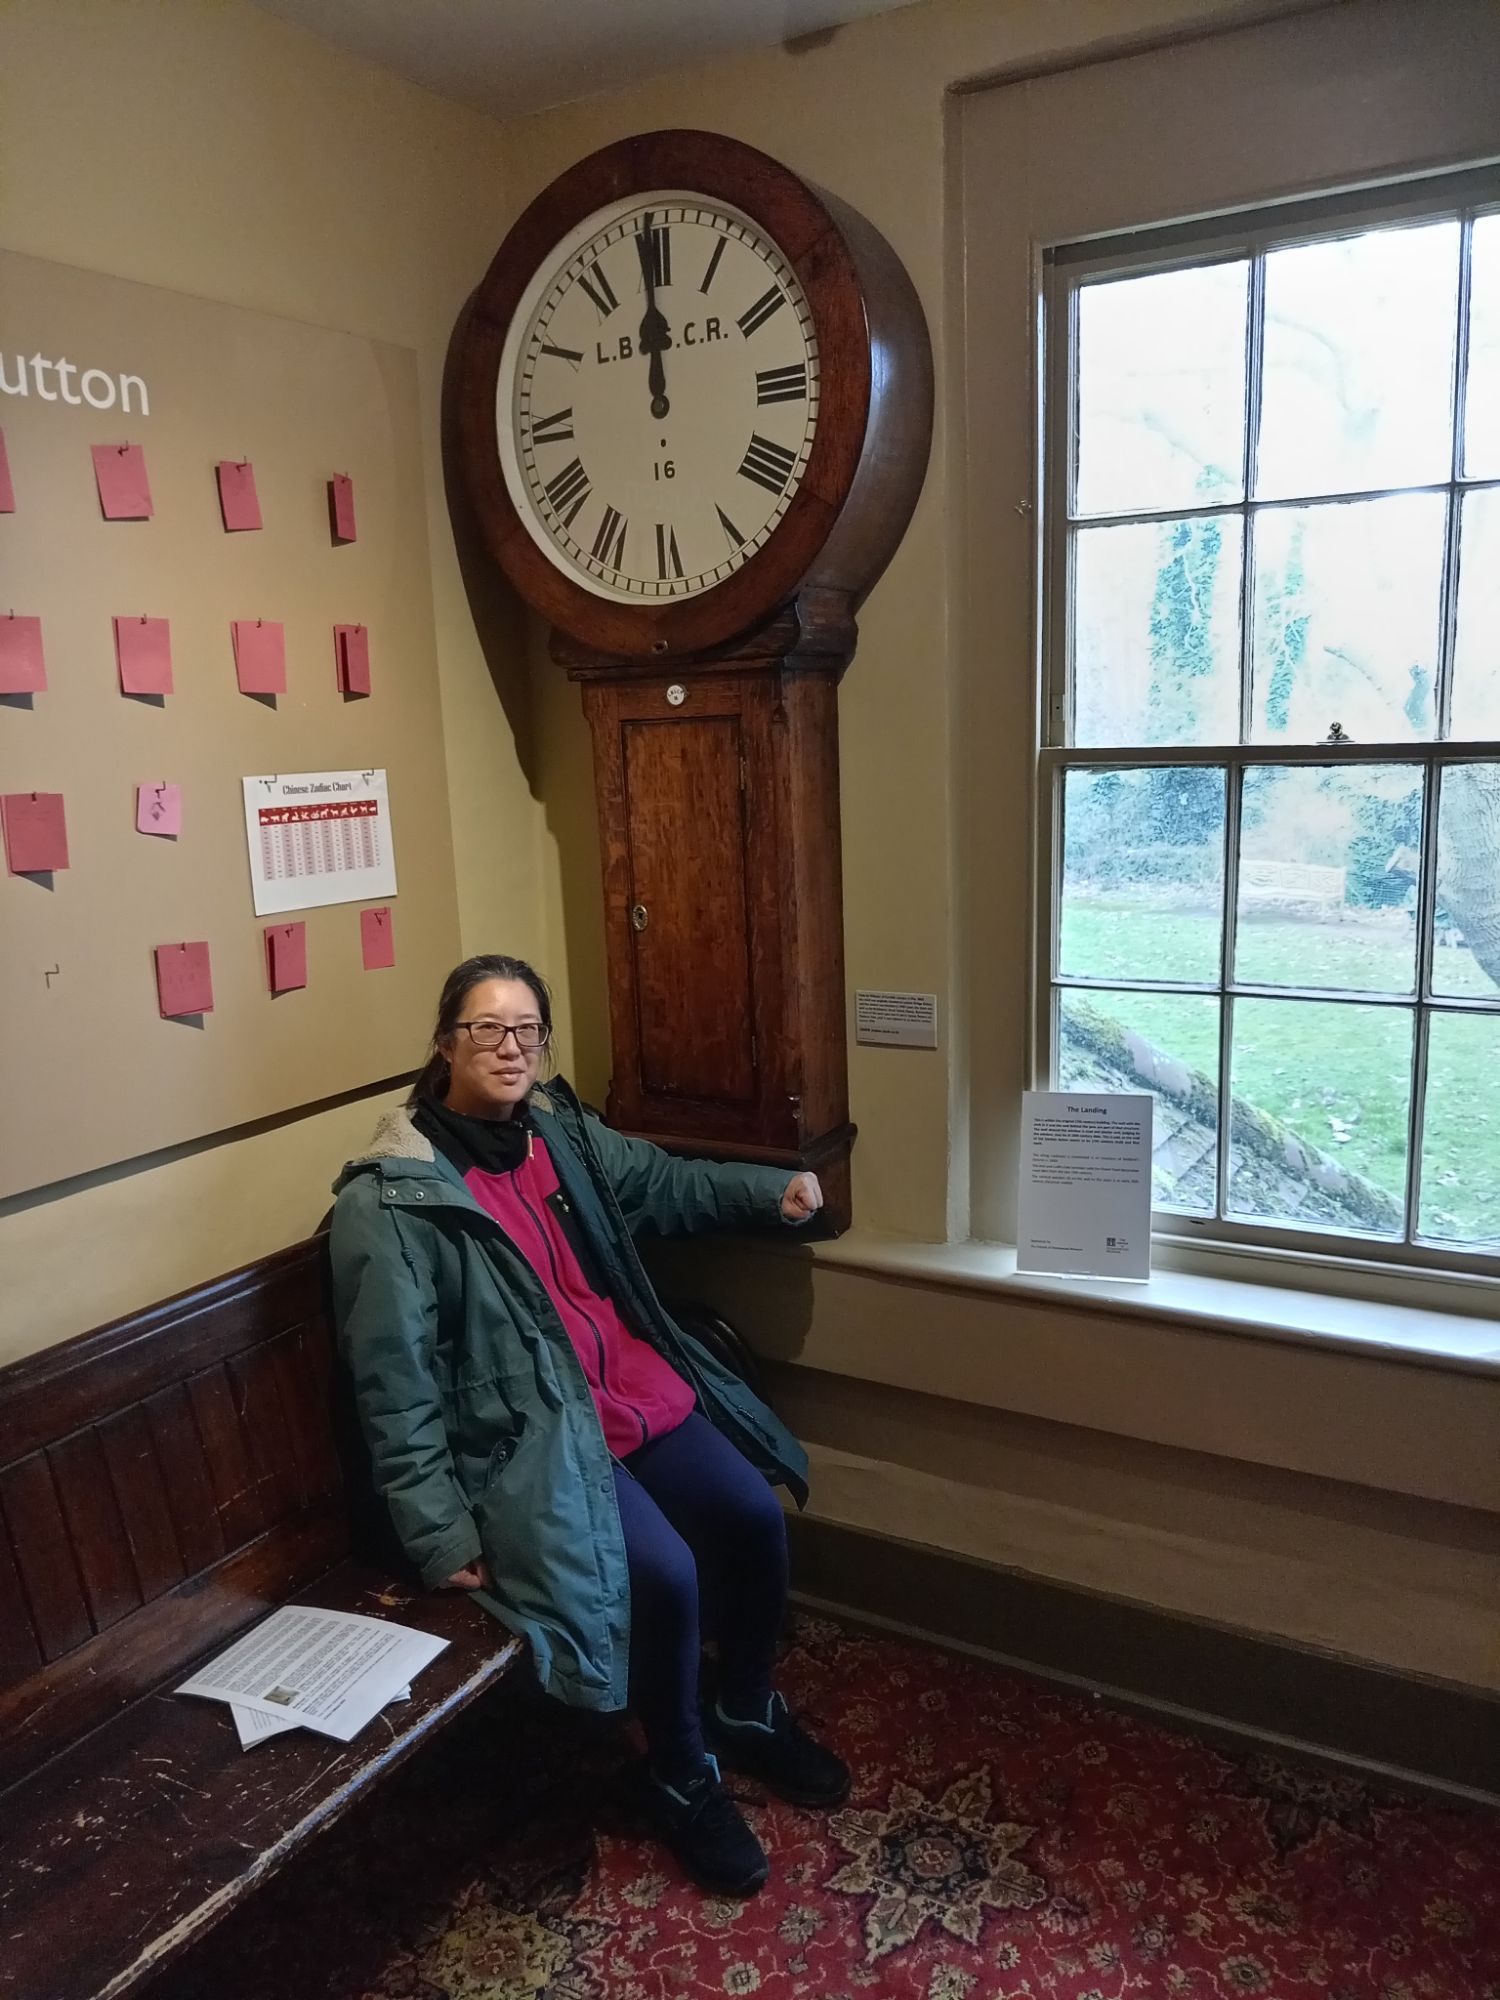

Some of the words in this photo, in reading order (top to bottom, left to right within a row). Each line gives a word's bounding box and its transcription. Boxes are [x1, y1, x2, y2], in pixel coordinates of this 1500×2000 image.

[654, 460, 675, 481] 16
[282, 784, 309, 795] Chinese
[309, 782, 332, 793] Zodiac
[332, 781, 352, 792] Chart
[1080, 1107, 1107, 1115] Landing
